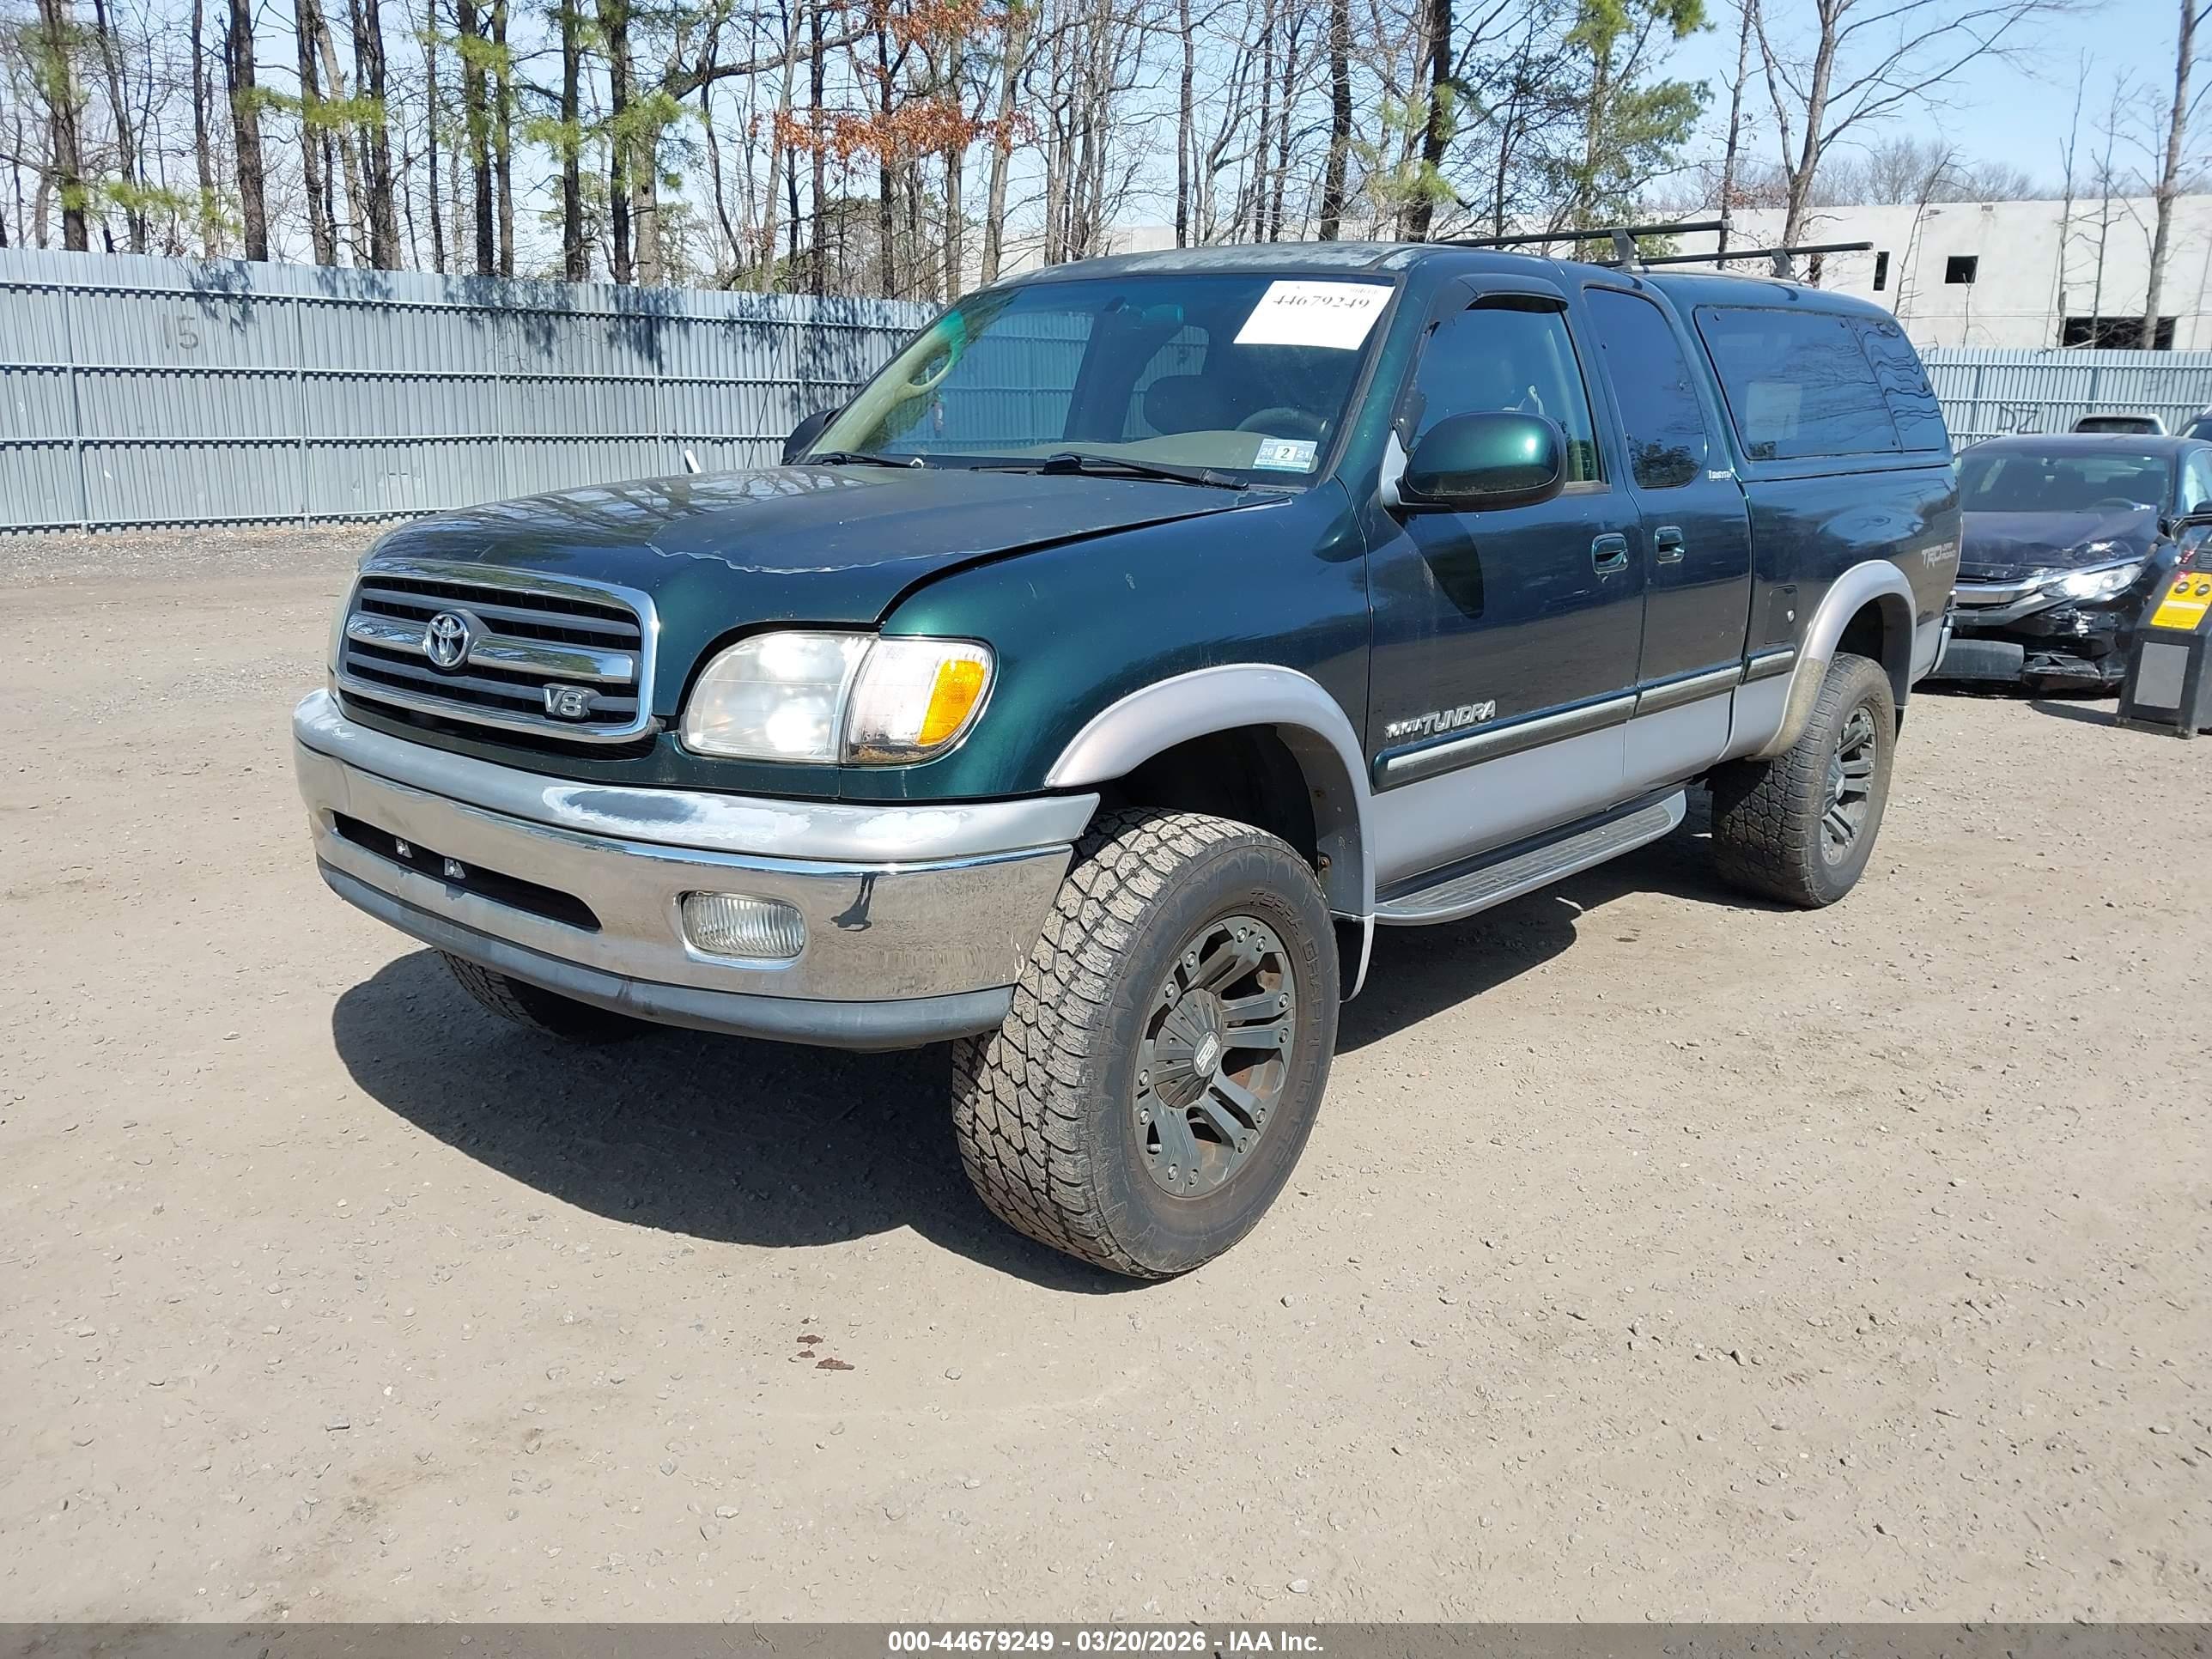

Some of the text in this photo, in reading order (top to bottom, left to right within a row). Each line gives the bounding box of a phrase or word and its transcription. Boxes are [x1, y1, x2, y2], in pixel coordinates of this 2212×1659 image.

[1273, 295, 1370, 309] 44679249
[162, 313, 198, 349] 15
[1279, 447, 1291, 459] 2
[544, 688, 582, 716] V8
[1422, 699, 1497, 736] TUNDRA
